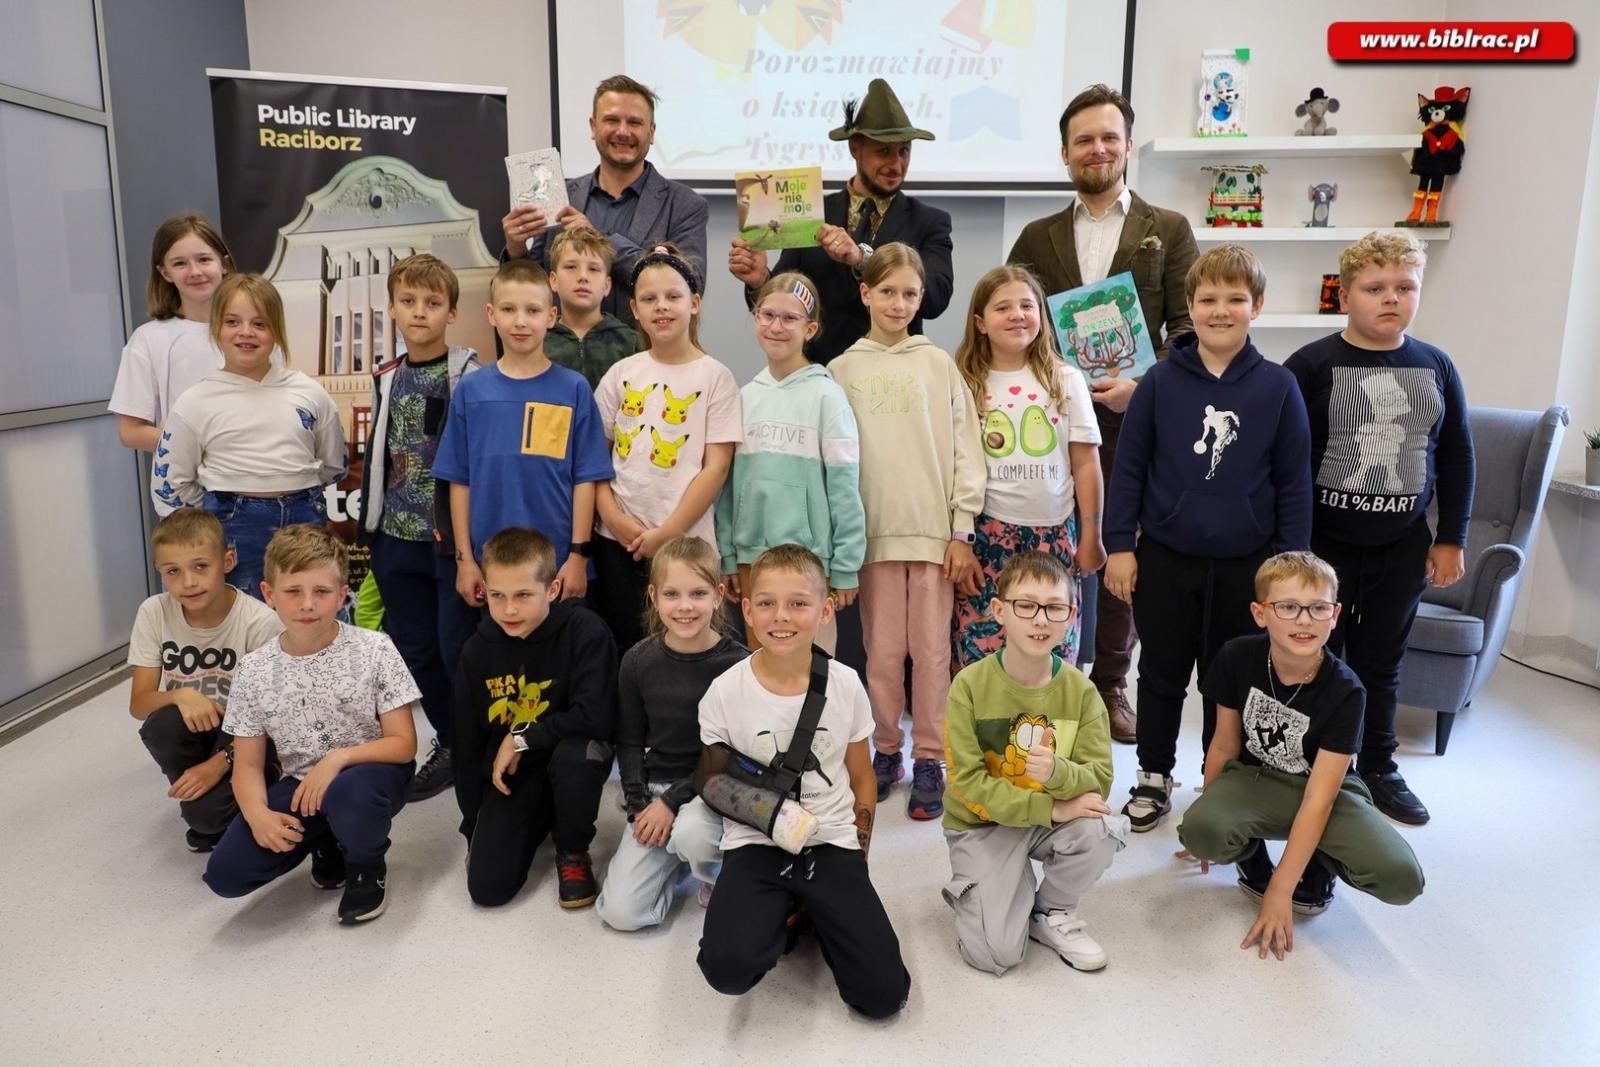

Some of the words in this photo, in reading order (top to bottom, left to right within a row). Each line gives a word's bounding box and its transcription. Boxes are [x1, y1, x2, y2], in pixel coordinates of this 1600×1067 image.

[743, 48, 1003, 80] Porozmawiajmy
[742, 97, 760, 118] o
[257, 104, 331, 127] Public
[337, 108, 416, 135] Library
[259, 128, 362, 151] Raciborz
[775, 179, 807, 194] Moje
[784, 201, 813, 215] moje
[997, 463, 1045, 480] COMPLETE
[1048, 464, 1061, 481] ME
[162, 641, 237, 675] GOOD
